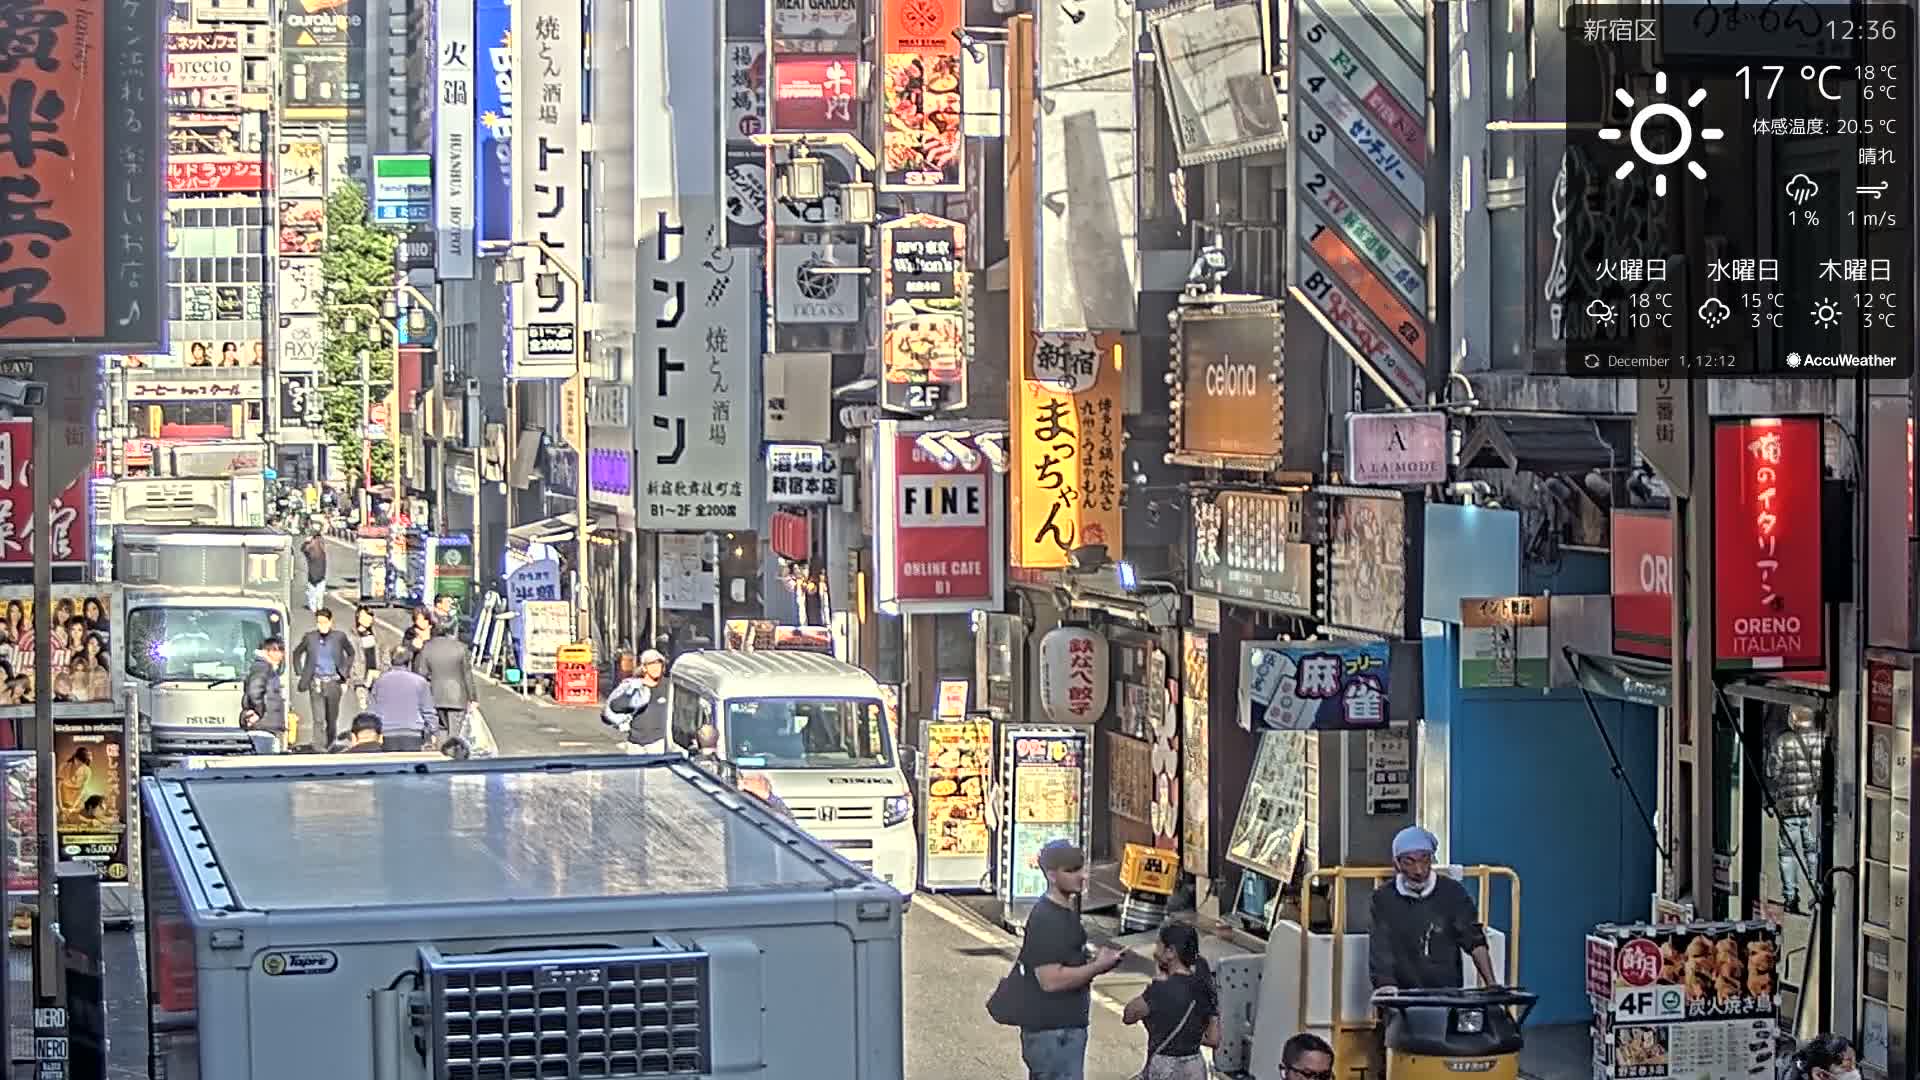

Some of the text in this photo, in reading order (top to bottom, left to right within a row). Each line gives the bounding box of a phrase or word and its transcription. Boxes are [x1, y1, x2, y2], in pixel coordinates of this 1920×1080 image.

[1306, 24, 1327, 43] 5
[443, 40, 468, 106] 火鍋
[535, 15, 562, 125] 焼とん酒場
[1307, 75, 1326, 93] 4
[1308, 123, 1327, 143] 3
[1306, 173, 1327, 195] 2
[1304, 271, 1333, 300] B1
[653, 212, 686, 465] トントン
[704, 327, 730, 446] 焼とん酒場
[1206, 355, 1256, 397] celona
[909, 386, 940, 406] 2F
[772, 477, 837, 494] 新宿本店
[1034, 398, 1078, 550] まっちゃん
[905, 487, 979, 514] FINE
[1748, 432, 1781, 605] 俺のイタリアン
[904, 560, 981, 577] ONLINE CAFE
[1734, 617, 1801, 634] ORENO
[1733, 636, 1801, 653] ITALIAN
[290, 955, 327, 967] Topre
[1618, 992, 1653, 1016] 4F
